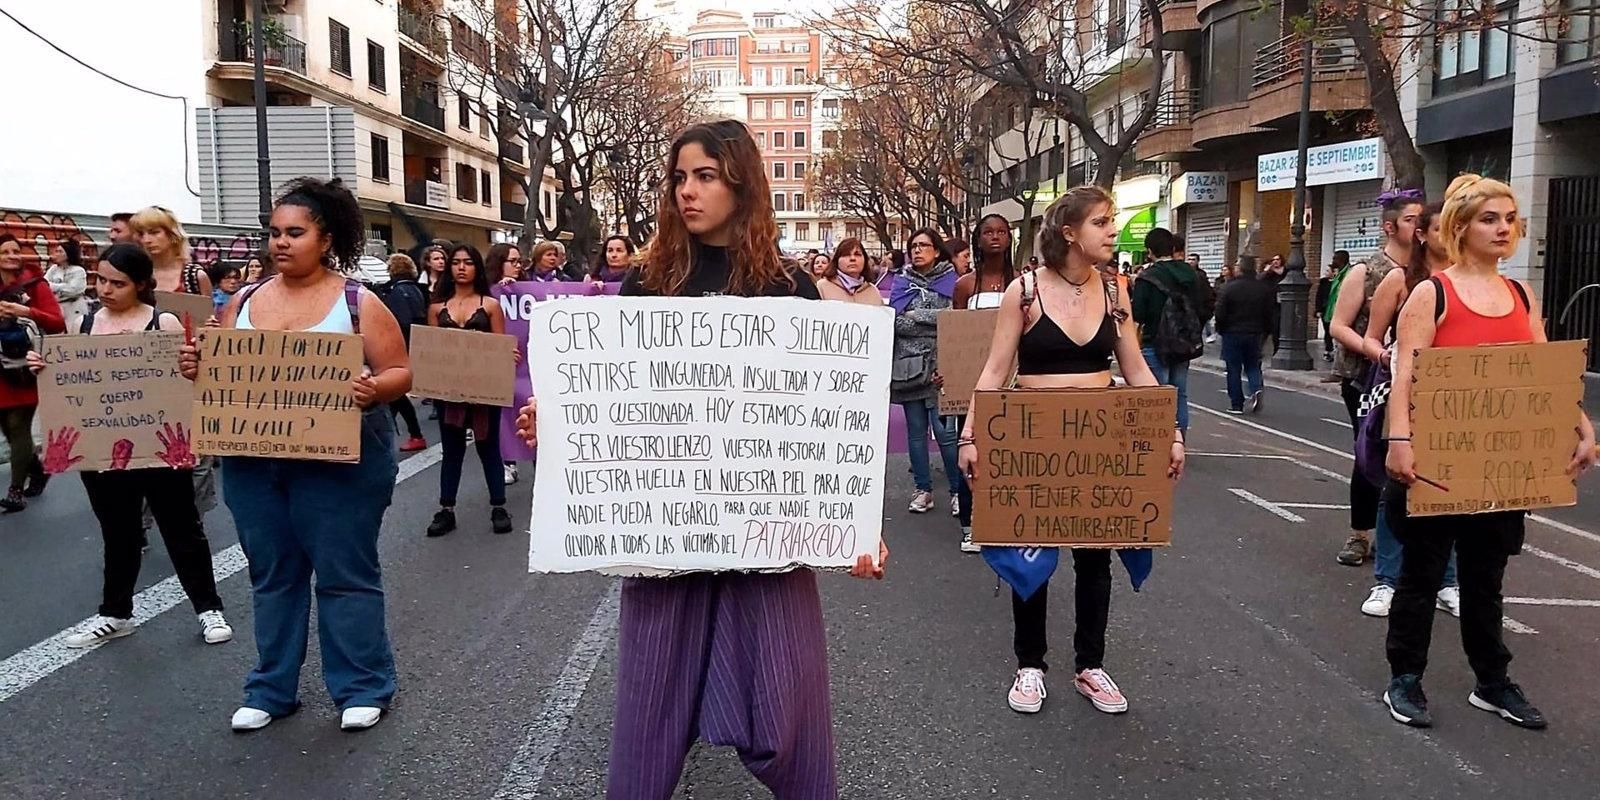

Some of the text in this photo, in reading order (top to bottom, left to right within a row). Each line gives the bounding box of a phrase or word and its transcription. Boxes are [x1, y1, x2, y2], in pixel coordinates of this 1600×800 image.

[1259, 158, 1287, 174] BAZAR
[1317, 143, 1377, 166] SEPTIEMBRE
[1187, 175, 1226, 187] BAZAR
[550, 310, 604, 353] SER
[620, 310, 683, 349] MUJER
[691, 312, 713, 348] ES
[720, 313, 775, 348] ESTAR
[785, 317, 869, 355] SILENCIADA
[76, 349, 97, 359] HAN
[105, 347, 143, 358] HECHO
[56, 368, 179, 385] BROMAS RESPECTO A
[227, 366, 244, 382] TE
[557, 361, 639, 394] SENTIRSE
[743, 362, 808, 391] INSULTADA
[813, 371, 822, 391] Y
[827, 372, 868, 393] SOBRE
[1470, 354, 1492, 378] TE
[1509, 353, 1533, 376] HA
[66, 390, 143, 406] TU CUERPO
[202, 390, 213, 406] O
[217, 390, 236, 407] TE
[1432, 388, 1552, 420] CRITICADO POR
[106, 407, 113, 415] O
[561, 404, 598, 425] TODO
[706, 397, 734, 423] HOY
[742, 404, 807, 427] ESTAMOS
[811, 406, 842, 430] AQUÍ
[844, 410, 870, 431] PARA
[201, 416, 220, 434] POR
[232, 417, 247, 434] LA
[1063, 409, 1107, 440] HAS
[568, 433, 602, 460] SER
[607, 434, 664, 460] VUESTRO
[723, 438, 772, 460] VUESTRA
[778, 441, 825, 461] HISTORIA
[837, 442, 874, 465] DEJAD
[1133, 440, 1154, 452] PIEL
[1429, 428, 1555, 452] LLEVAR CIERTO TIPO
[1065, 450, 1149, 478] CULPABLE
[1437, 463, 1453, 480] DE
[565, 468, 872, 496] VUESTRA HUELLA EN NUESTRA PIEL PARA QUE
[990, 484, 1132, 508] POR TENER SEXO
[567, 504, 605, 525] NADIE
[612, 501, 652, 525] PUEDA
[725, 501, 745, 515] PARA
[750, 502, 772, 517] QUE
[780, 500, 810, 518] NADIE
[819, 502, 853, 520] PUEDA
[1014, 514, 1024, 537] O
[564, 519, 857, 560] OLVIDAR A TODAS LAS VÍCTIMAS DEL PATRIARCADO
